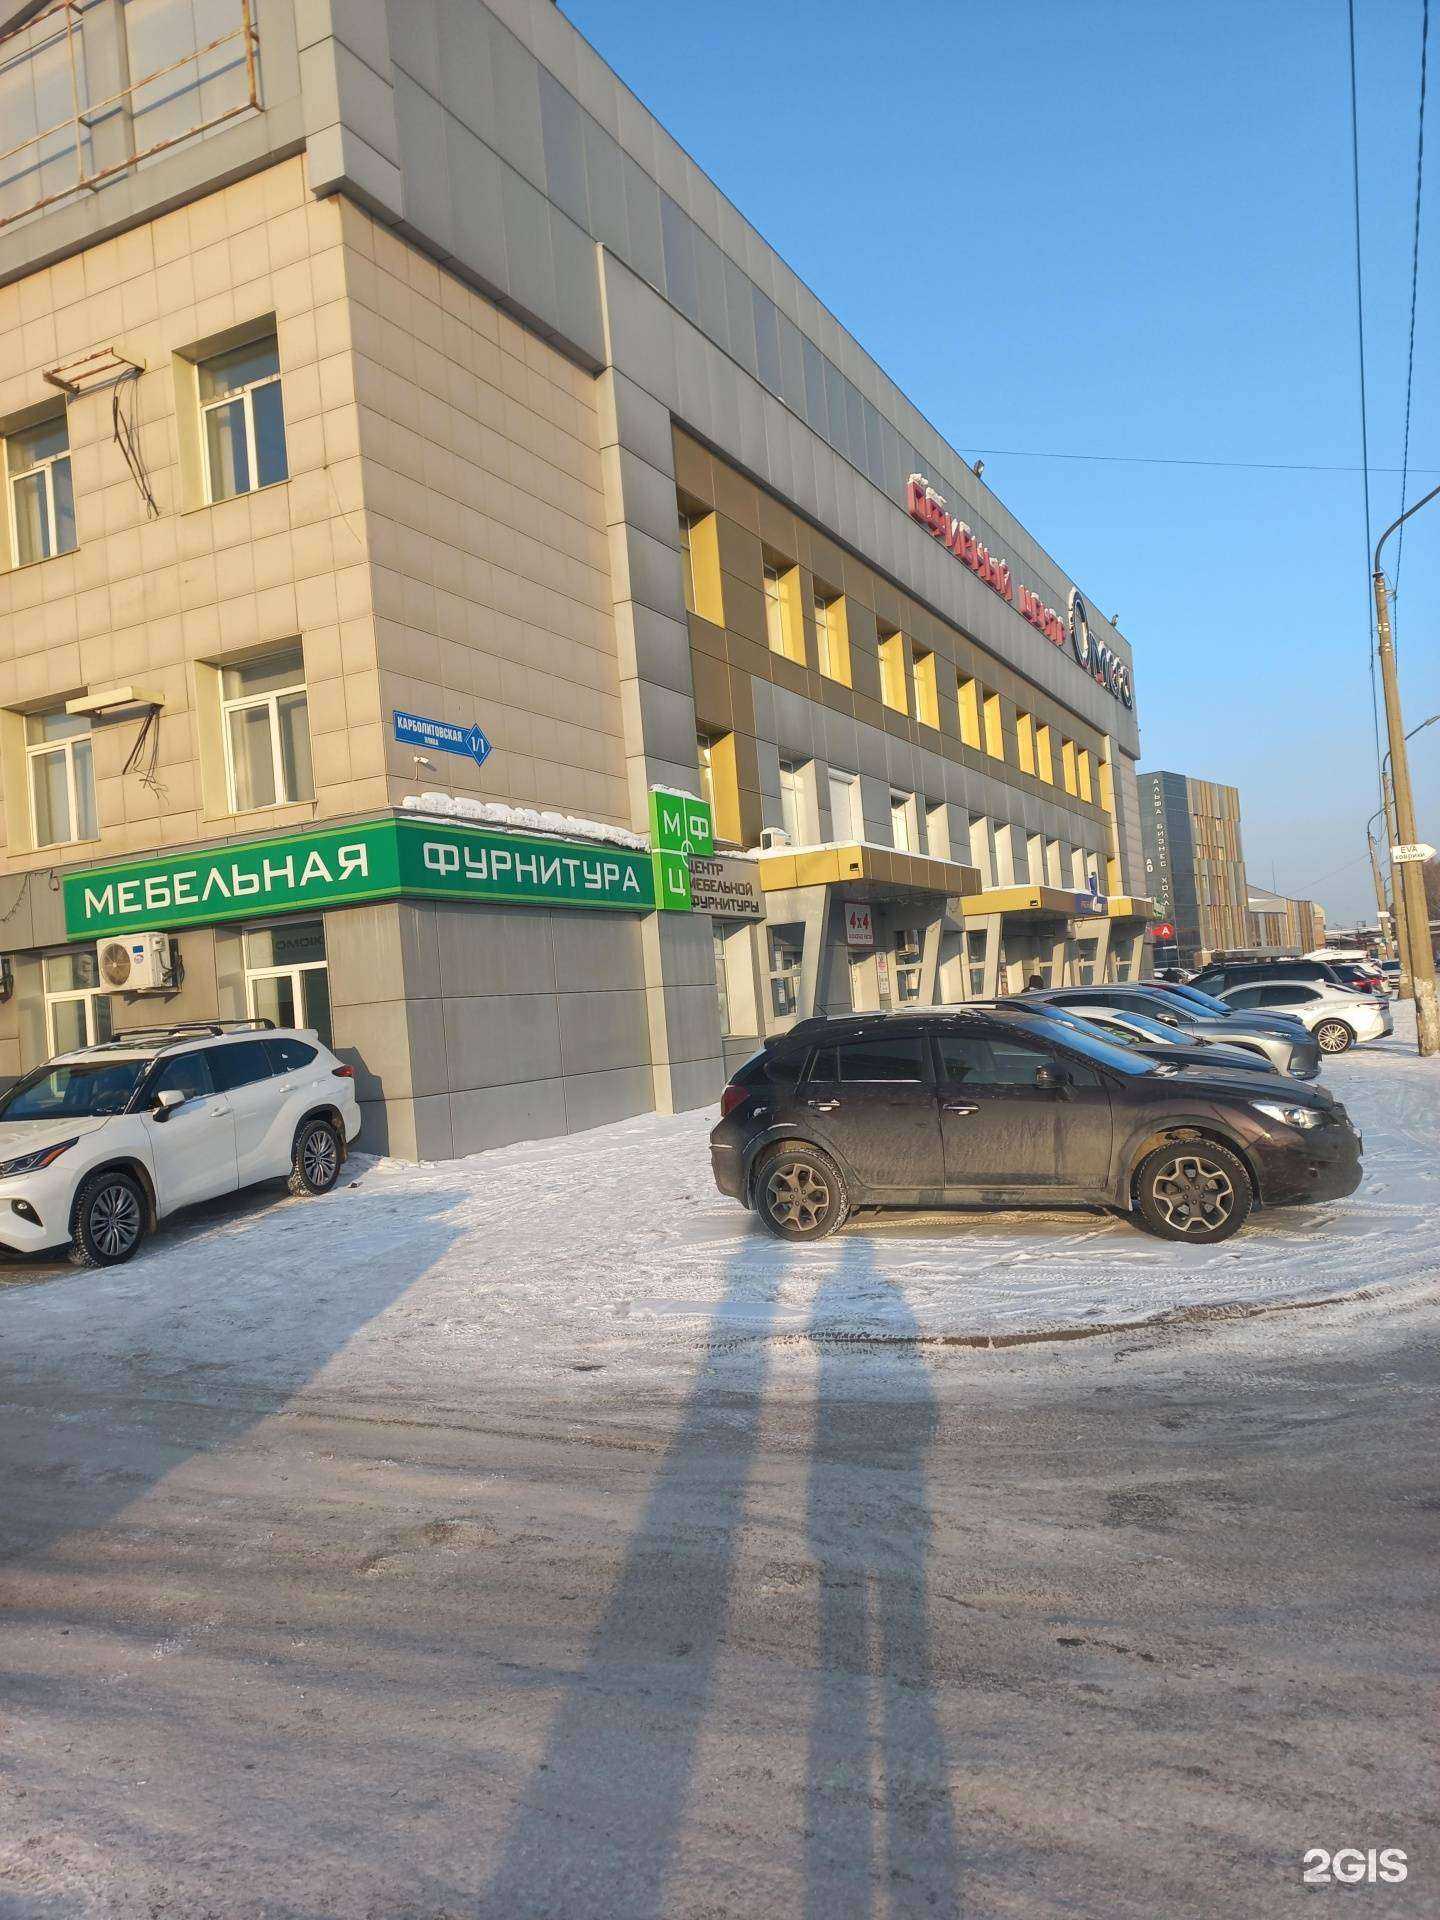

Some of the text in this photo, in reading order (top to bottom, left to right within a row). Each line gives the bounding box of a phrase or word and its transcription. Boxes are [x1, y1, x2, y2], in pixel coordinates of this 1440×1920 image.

[397, 715, 486, 754] КАРБОЛИТОВСКАЯ 1/1
[422, 842, 641, 893] ФУРНИТУРА
[1400, 845, 1418, 854] EVA
[84, 843, 369, 919] МЕБЕЛЬНАЯ
[668, 867, 686, 897] Ц
